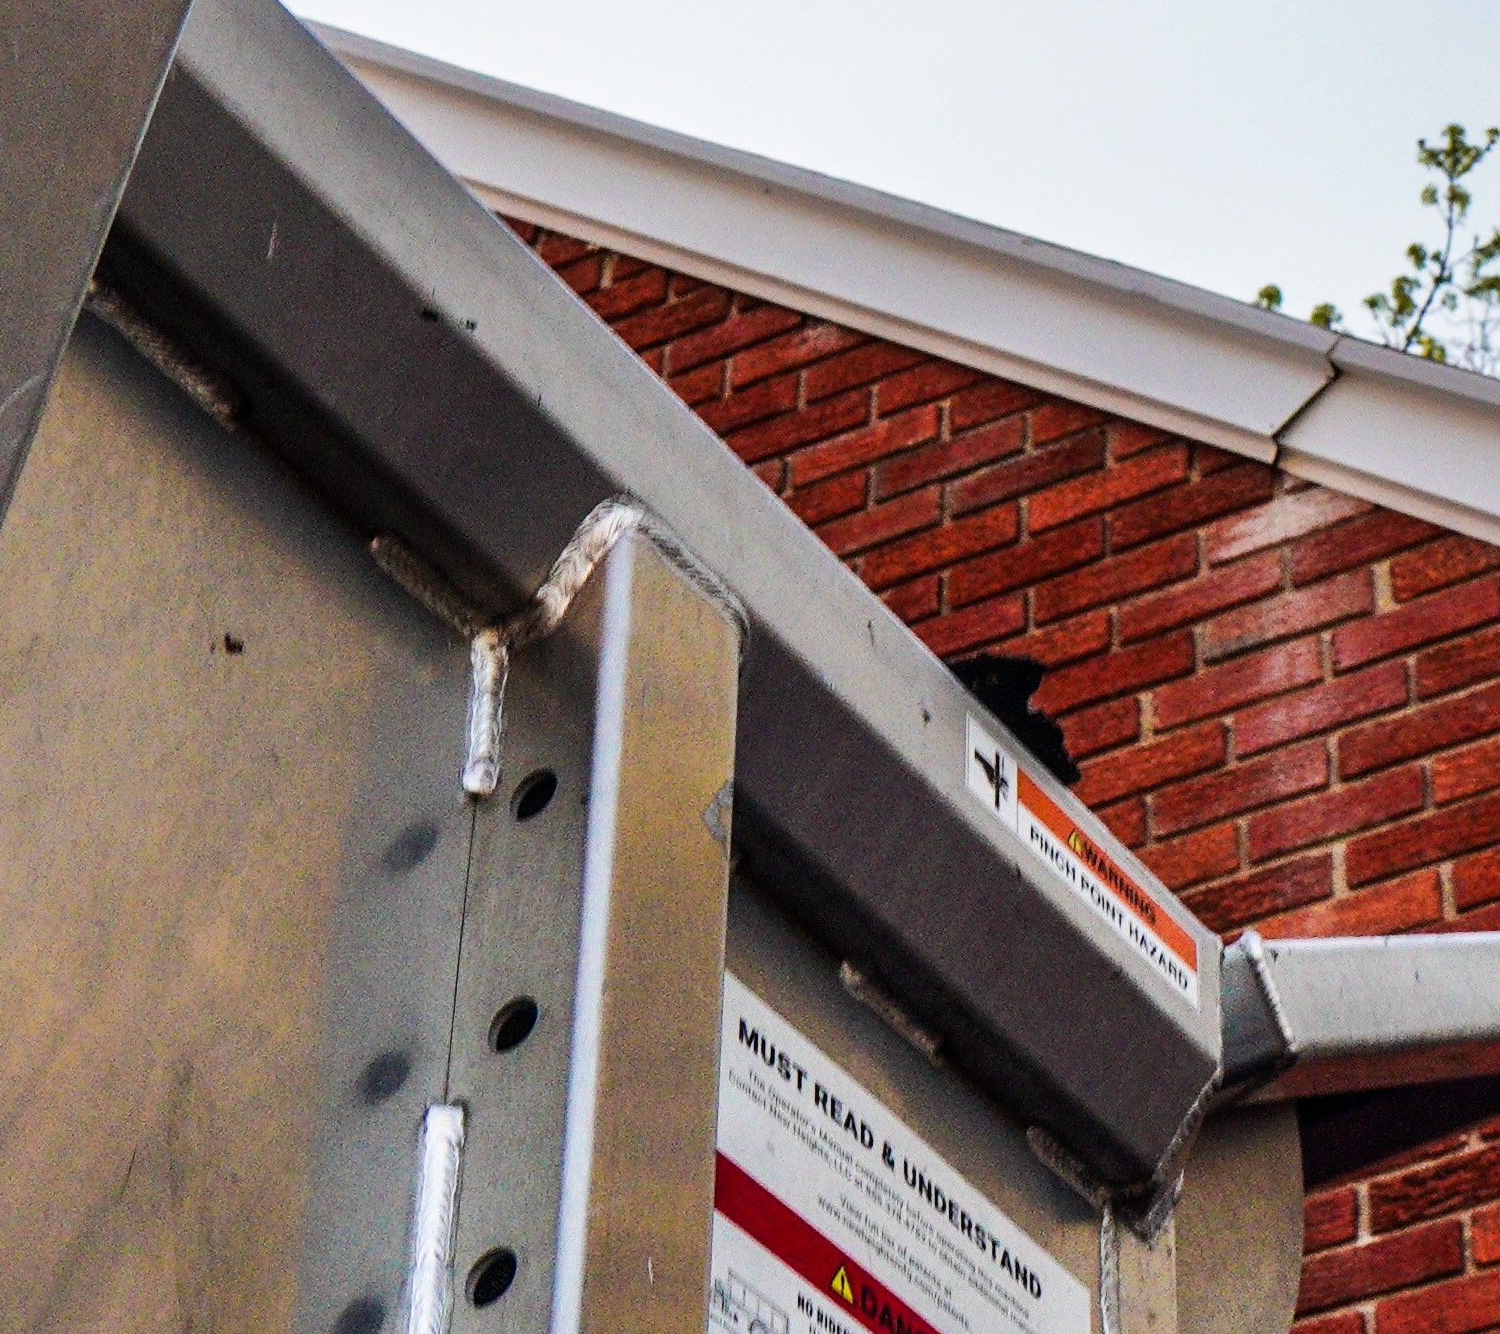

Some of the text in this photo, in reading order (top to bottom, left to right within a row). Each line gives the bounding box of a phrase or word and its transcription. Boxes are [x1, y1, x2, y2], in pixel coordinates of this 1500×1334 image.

[1030, 825, 1187, 992] PINCH POINT HAZARD
[1083, 838, 1156, 928] WARNING
[738, 1015, 1041, 1303] MUST READ & UNDERSTAND
[797, 1291, 812, 1319] NO
